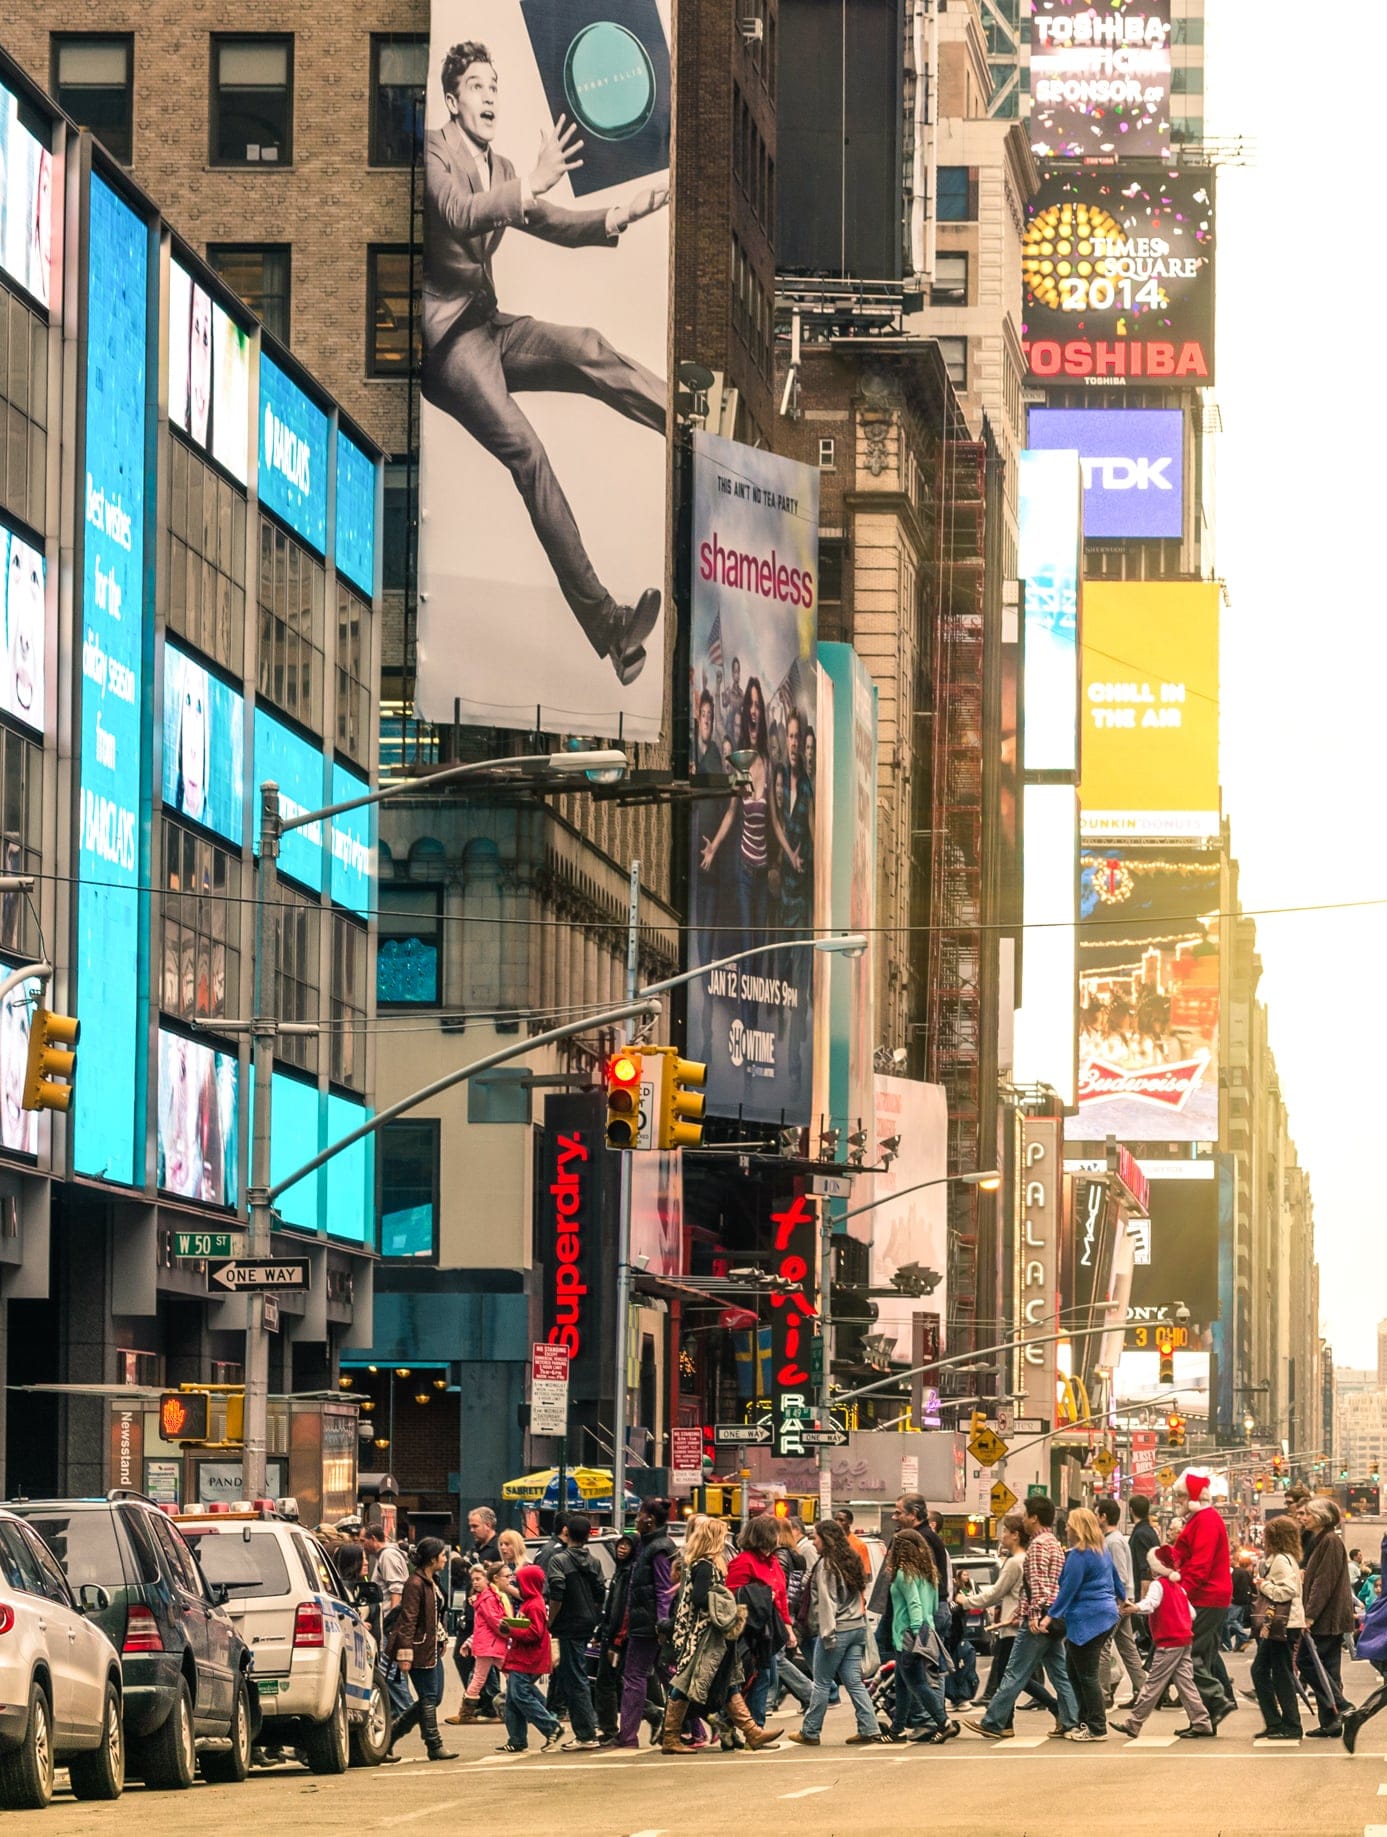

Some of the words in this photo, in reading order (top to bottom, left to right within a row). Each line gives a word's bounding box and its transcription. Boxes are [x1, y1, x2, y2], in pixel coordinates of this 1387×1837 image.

[1034, 16, 1166, 41] TOSHIBA
[1036, 80, 1142, 102] SPONSOR
[1090, 237, 1162, 257] TIMES
[1104, 258, 1197, 281] SQUARE
[1084, 377, 1126, 386] TOSHIBA
[1080, 457, 1173, 490] TDK
[717, 476, 732, 495] THIS
[734, 483, 751, 502] AIN'T
[752, 486, 762, 504] NO
[763, 489, 776, 508] TEA
[778, 494, 799, 516] PARTY
[700, 532, 813, 609] shameless
[1087, 682, 1155, 703] CHILL
[1160, 682, 1186, 703] IN
[1091, 708, 1136, 728] THE
[1141, 708, 1182, 728] AIR
[707, 970, 726, 997] JAN
[727, 972, 738, 998] 12
[741, 974, 781, 1005] SUNDAYS
[728, 1019, 776, 1067] SHOWTIME
[1079, 1067, 1204, 1096] Budweiser
[179, 1234, 190, 1255] W
[195, 1235, 211, 1255] 50
[216, 1235, 227, 1247] ST
[1026, 1142, 1046, 1365] PALACE
[226, 1269, 257, 1282] ONE
[265, 1268, 296, 1281] WAY
[1125, 1306, 1168, 1320] ONY
[1135, 1327, 1148, 1347] 3
[723, 1428, 741, 1439] ONE
[747, 1428, 765, 1438] WAY
[827, 1434, 842, 1442] WAY
[120, 1411, 133, 1486] Newsstand
[1132, 1451, 1156, 1463] JERSEY
[208, 1476, 272, 1488] PANDA
[505, 1487, 544, 1496] SABRETT
